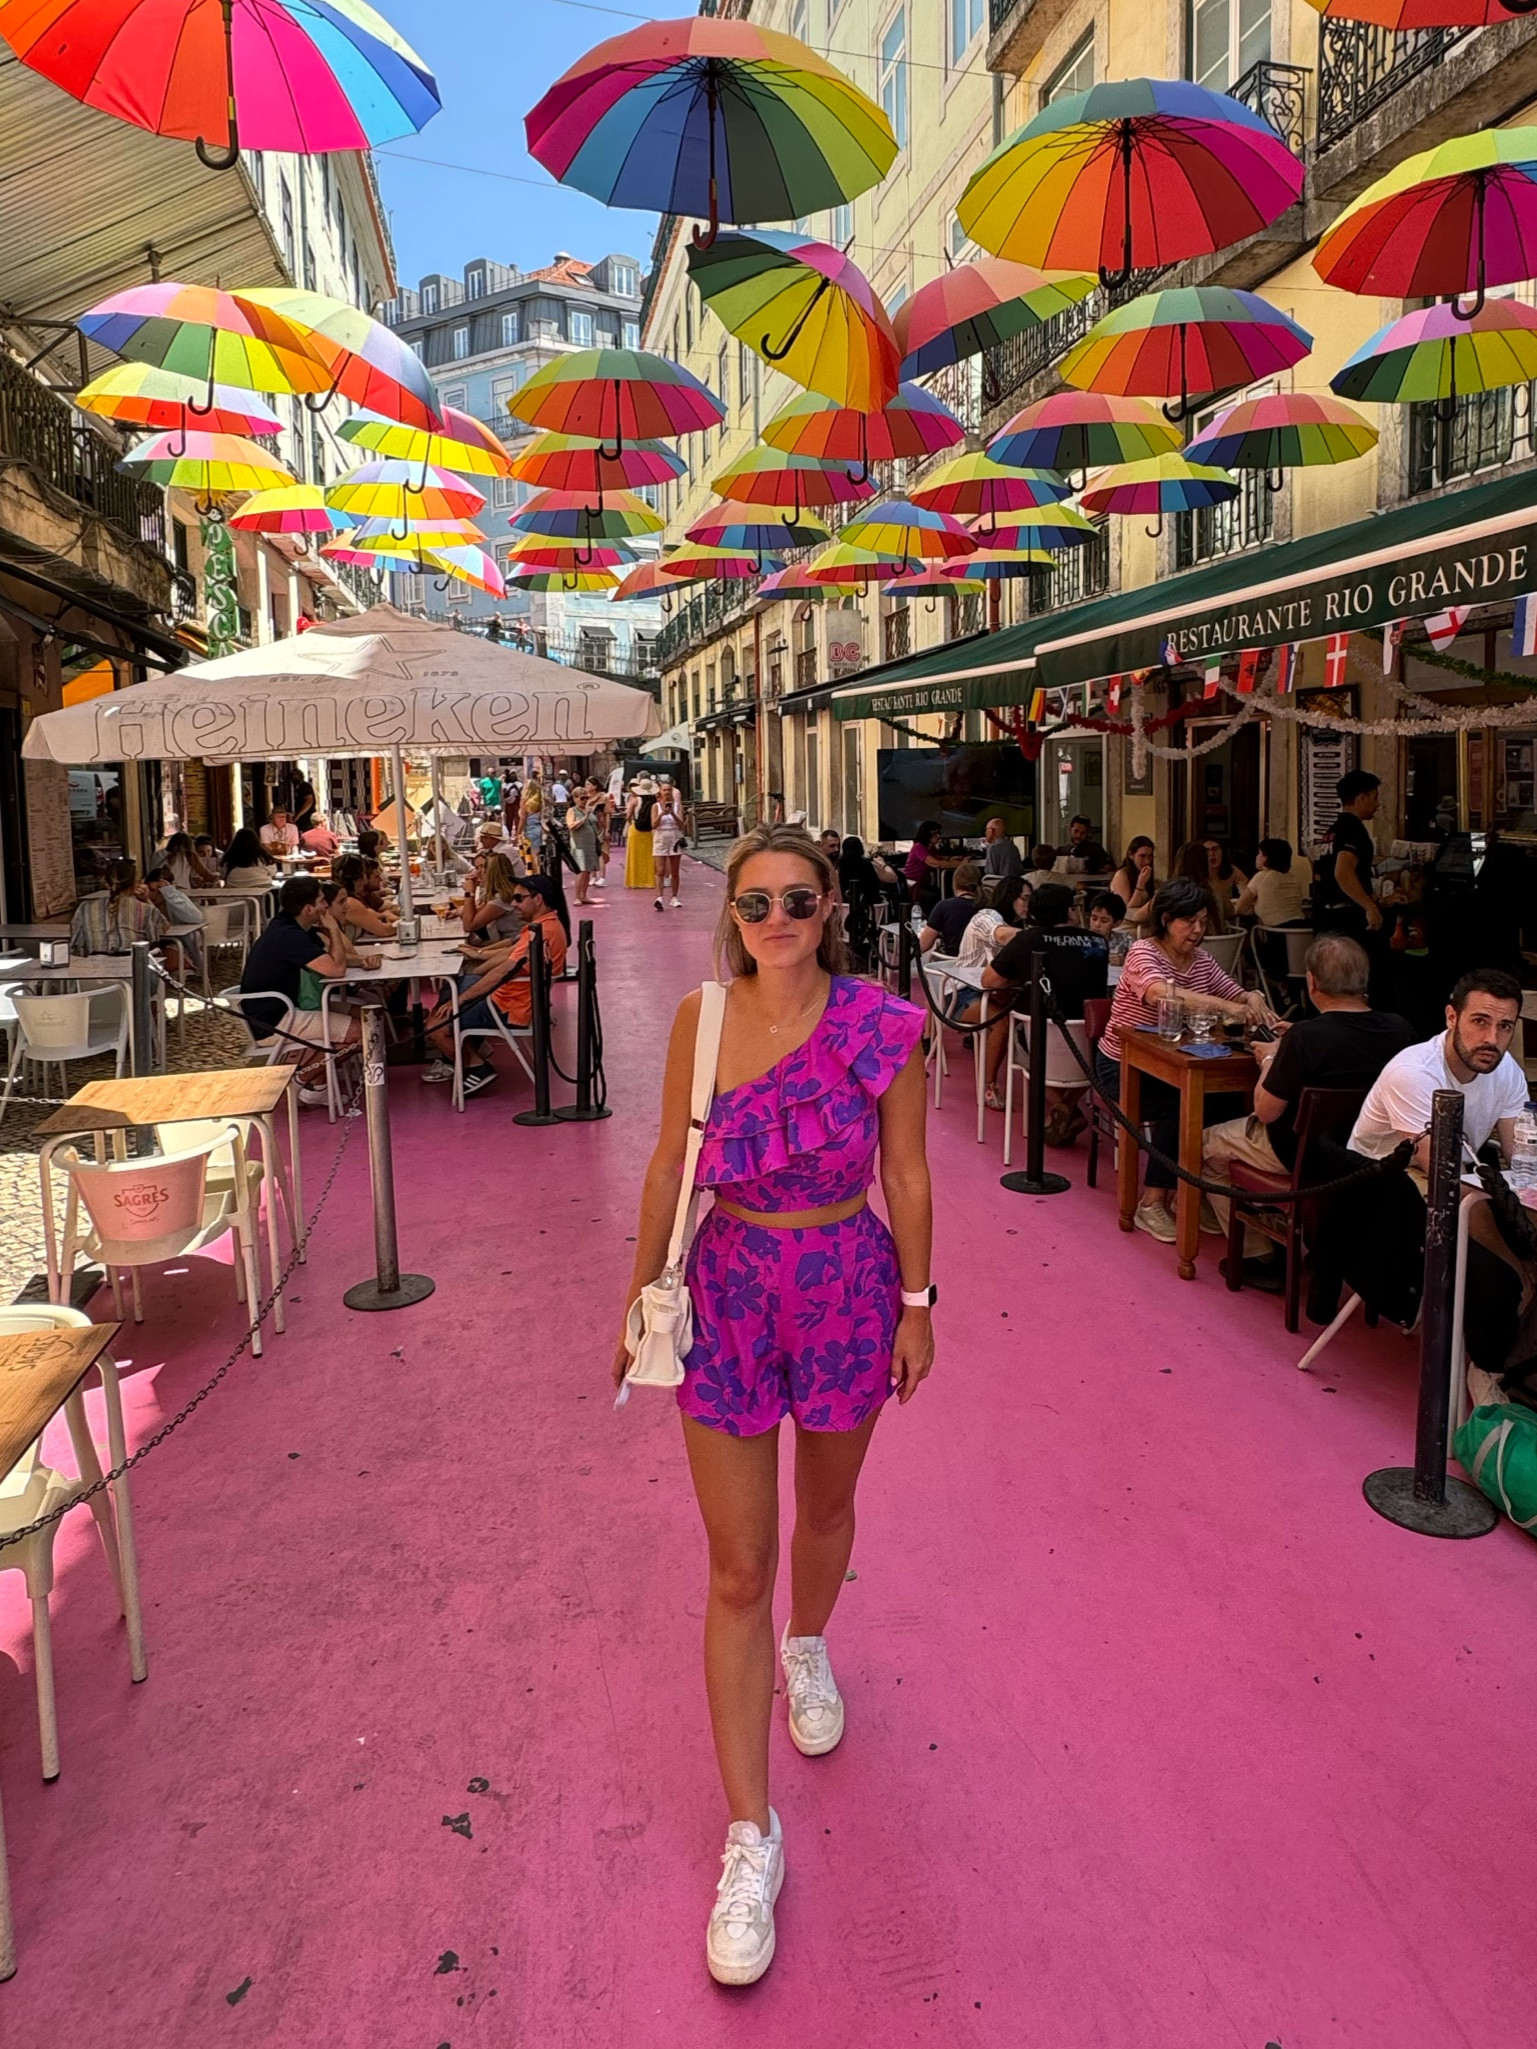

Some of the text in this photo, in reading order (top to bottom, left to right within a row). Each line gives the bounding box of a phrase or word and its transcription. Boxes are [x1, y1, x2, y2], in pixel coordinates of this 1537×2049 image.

[1166, 545, 1528, 654] RESTAURANTE RIO GRANDE
[915, 691, 928, 707] RIO
[931, 687, 962, 705] GRANDE
[90, 687, 595, 763] Heineken
[113, 1188, 169, 1208] SAGRES
